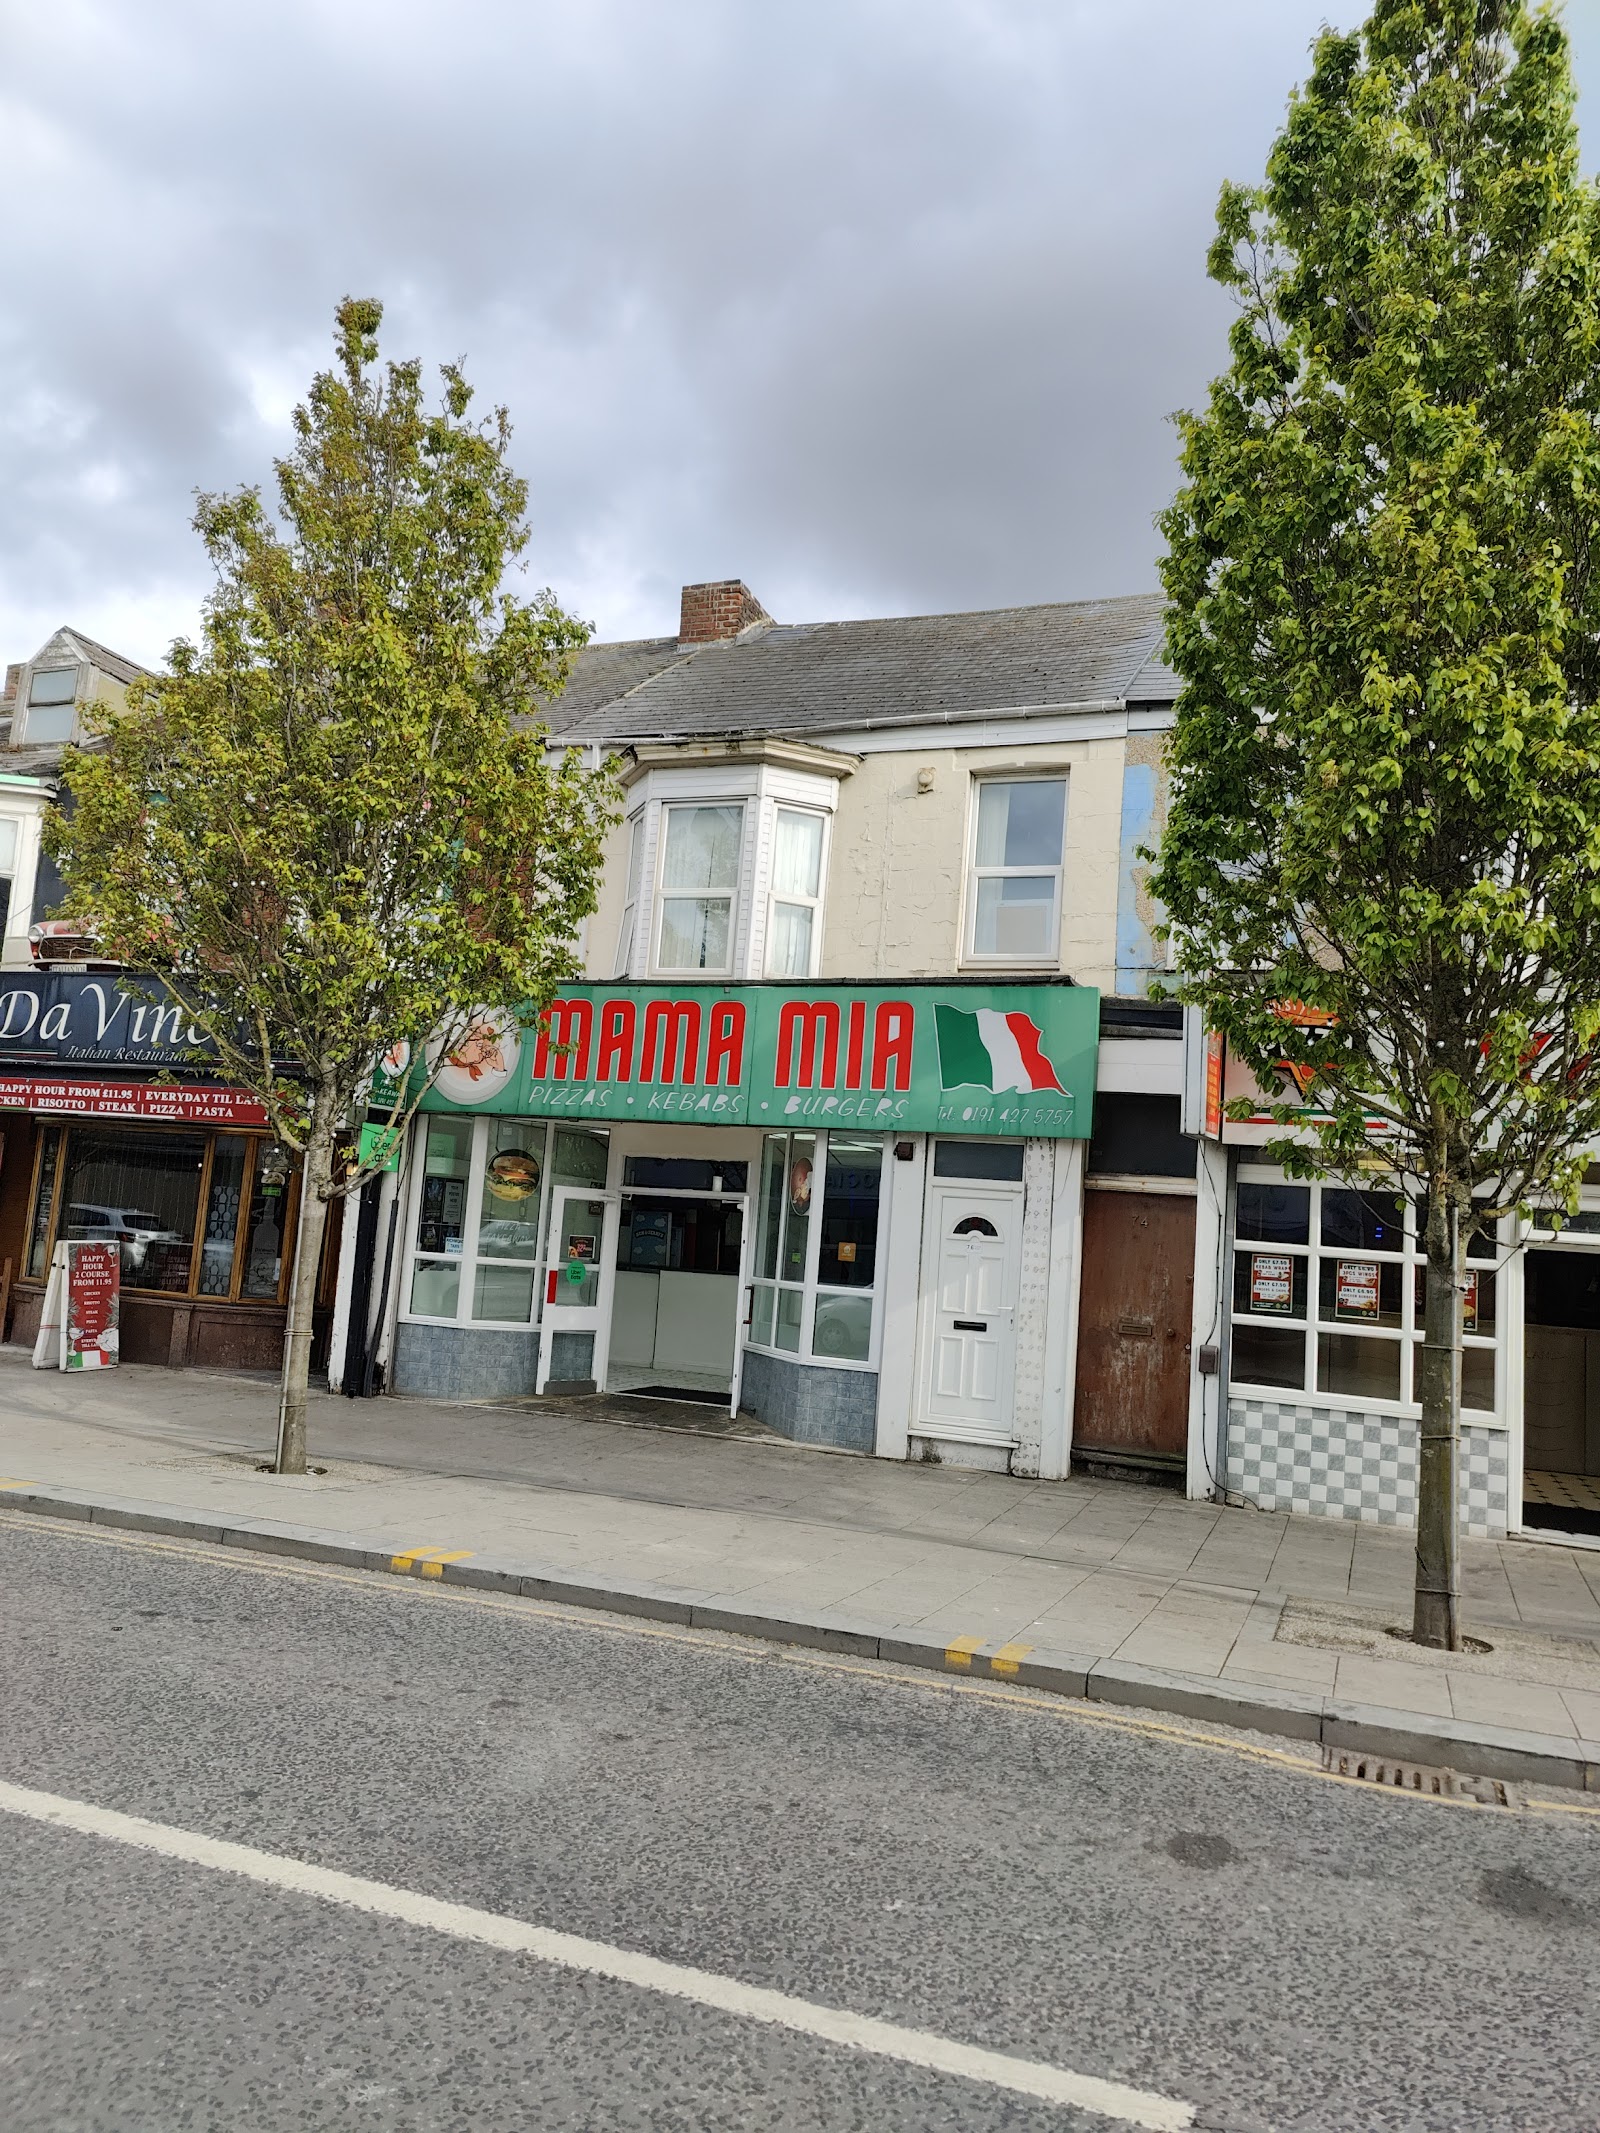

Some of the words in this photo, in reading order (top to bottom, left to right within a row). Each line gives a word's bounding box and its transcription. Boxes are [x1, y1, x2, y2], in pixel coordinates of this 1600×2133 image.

[0, 990, 72, 1040] Da
[80, 983, 212, 1043] Vinc
[65, 1045, 111, 1059] Italian
[113, 1047, 189, 1063] Restauran
[531, 998, 747, 1087] MAMA
[773, 1000, 915, 1092] MIA
[0, 1084, 32, 1094] HAPPY
[34, 1085, 66, 1096] HOUR
[68, 1087, 100, 1098] FROM
[102, 1089, 133, 1099] £11.95
[145, 1091, 210, 1103] EVERYDAY
[212, 1094, 233, 1104] TIL
[235, 1095, 263, 1106] LAT
[528, 1086, 613, 1107] PIZZAS
[648, 1091, 745, 1113] KEBABS
[784, 1096, 910, 1118] BURGERS
[37, 1098, 86, 1109] RISOTTO
[98, 1101, 137, 1112] STEAK
[149, 1104, 184, 1115] PIZZA
[195, 1106, 234, 1117] PASTA
[938, 1106, 956, 1120] Tel:
[962, 1106, 995, 1121] 0191
[999, 1108, 1030, 1123] 427
[1033, 1108, 1074, 1124] 5757
[371, 1137, 391, 1150] Uer
[1132, 1215, 1149, 1228] 74
[96, 1278, 112, 1286] 11.95
